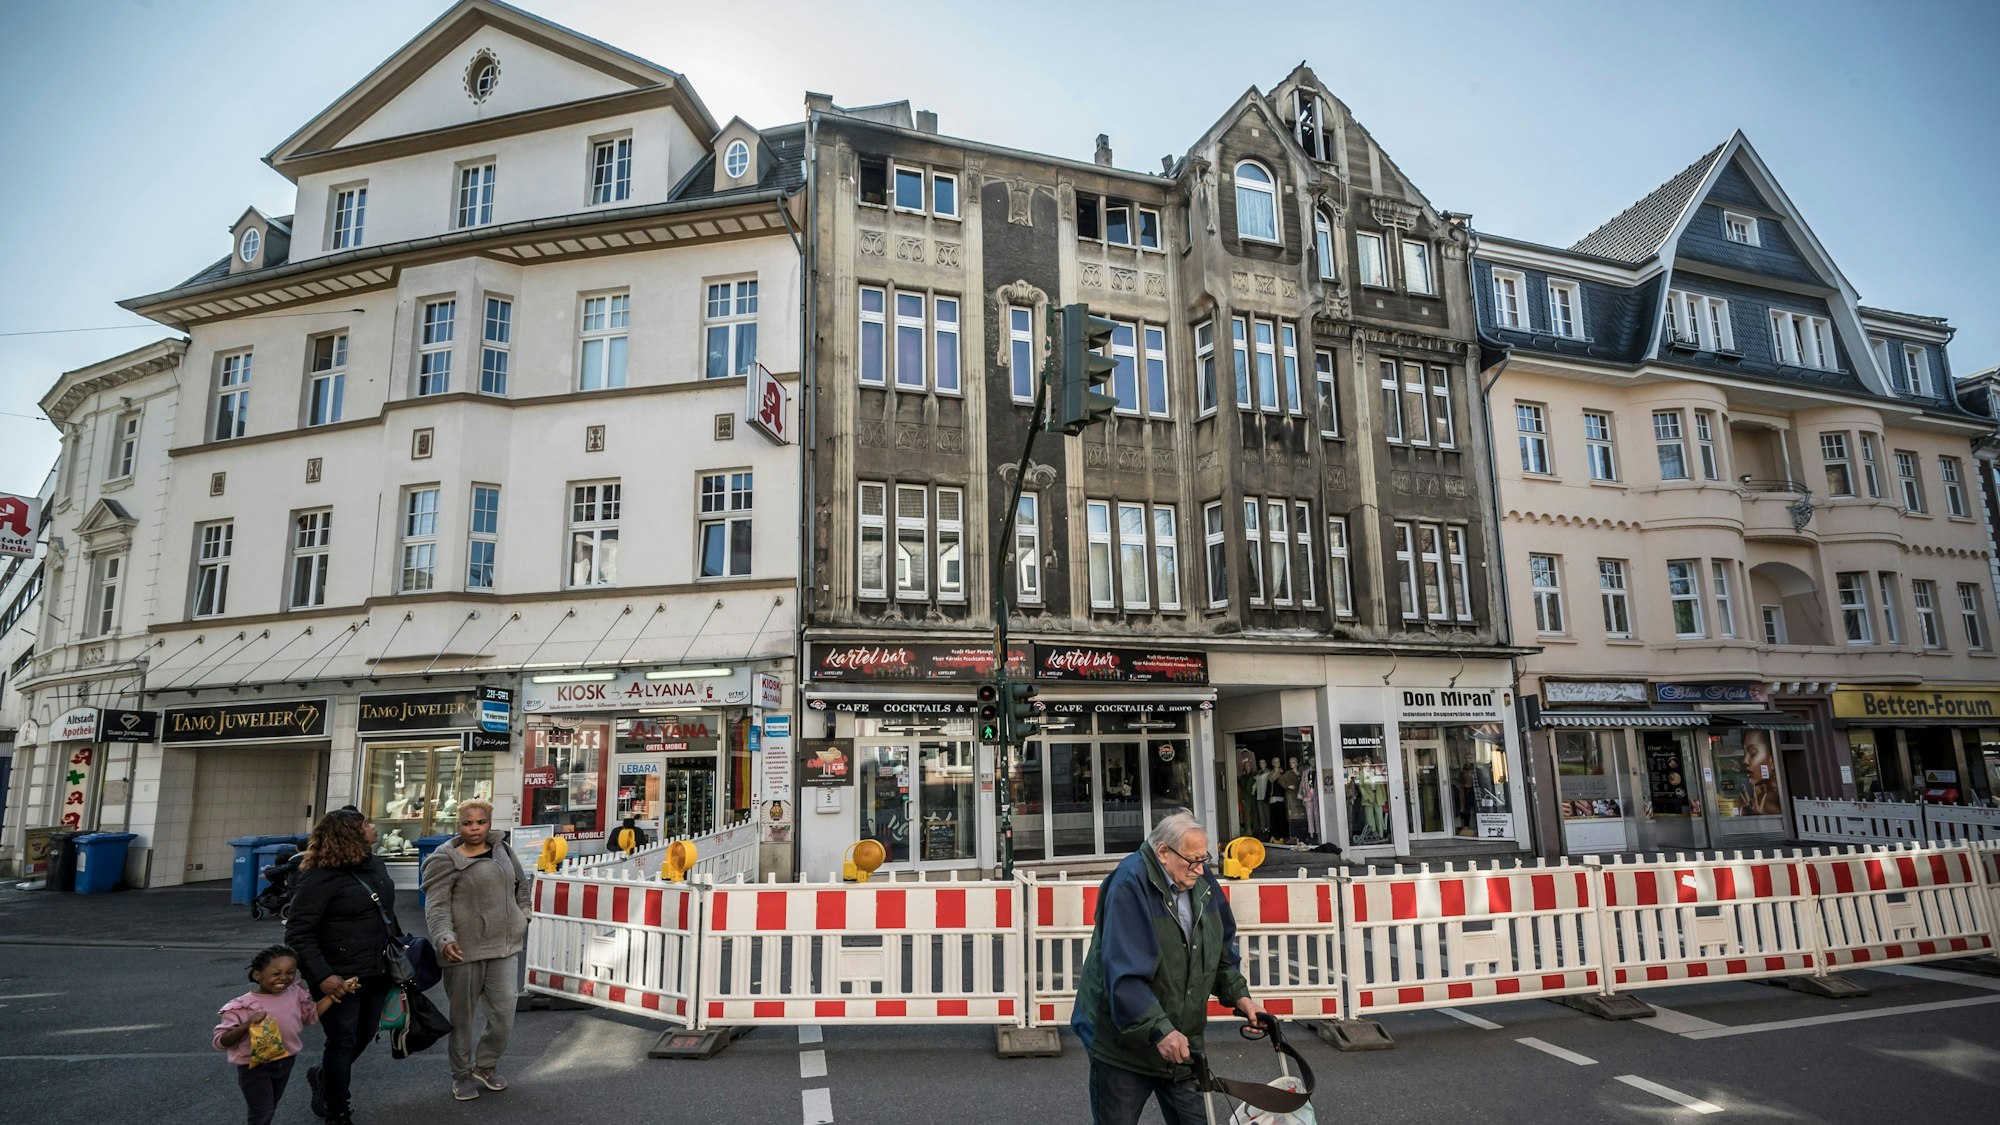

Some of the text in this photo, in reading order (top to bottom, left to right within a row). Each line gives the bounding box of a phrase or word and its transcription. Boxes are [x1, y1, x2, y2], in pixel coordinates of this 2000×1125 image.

[0, 543, 32, 553] heke
[1, 537, 28, 546] tadt
[826, 646, 909, 670] kartel bar
[1048, 648, 1115, 671] kartel bar
[558, 682, 696, 701] KIOSK ALYANA
[1403, 691, 1492, 706] Don Miran
[1660, 685, 1747, 700] Blue Nails
[836, 704, 870, 712] CAFE
[884, 704, 951, 713] COCKTAILS
[956, 704, 965, 712] &
[1095, 704, 1154, 712] COCKTAILS
[1157, 704, 1166, 712] &
[1862, 692, 1993, 716] Betten-Forum
[66, 713, 94, 724] Altstadt
[361, 702, 466, 722] TAMO JUWELIER
[172, 710, 296, 736] TAMO JUWELIER
[626, 720, 709, 742] ALYANA
[621, 764, 658, 774] LEBARA
